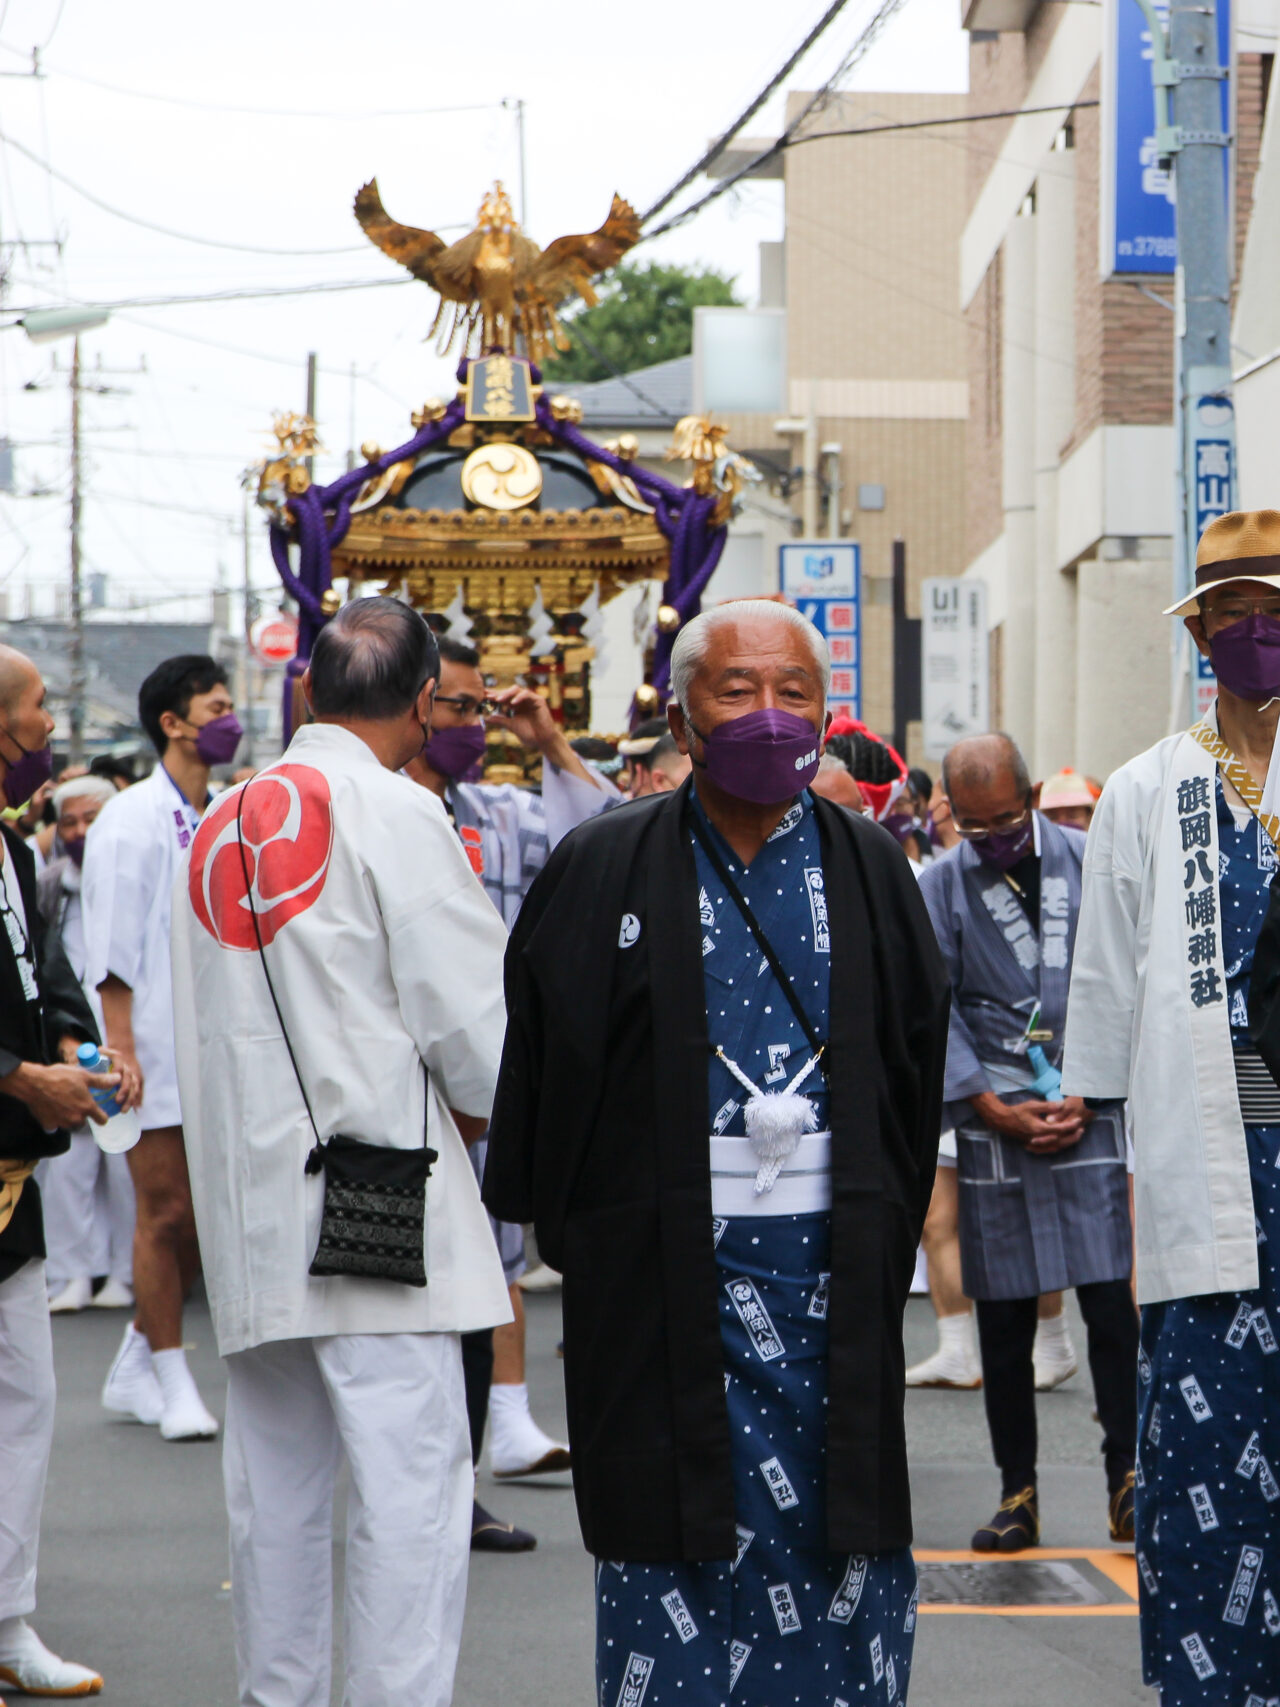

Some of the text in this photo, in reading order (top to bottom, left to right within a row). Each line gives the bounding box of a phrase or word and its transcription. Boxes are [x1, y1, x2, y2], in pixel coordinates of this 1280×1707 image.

[1177, 777, 1223, 1008] 旗岡八幡神社
[741, 1301, 780, 1356] 旗岡八幡
[668, 1595, 693, 1638] 旗の台
